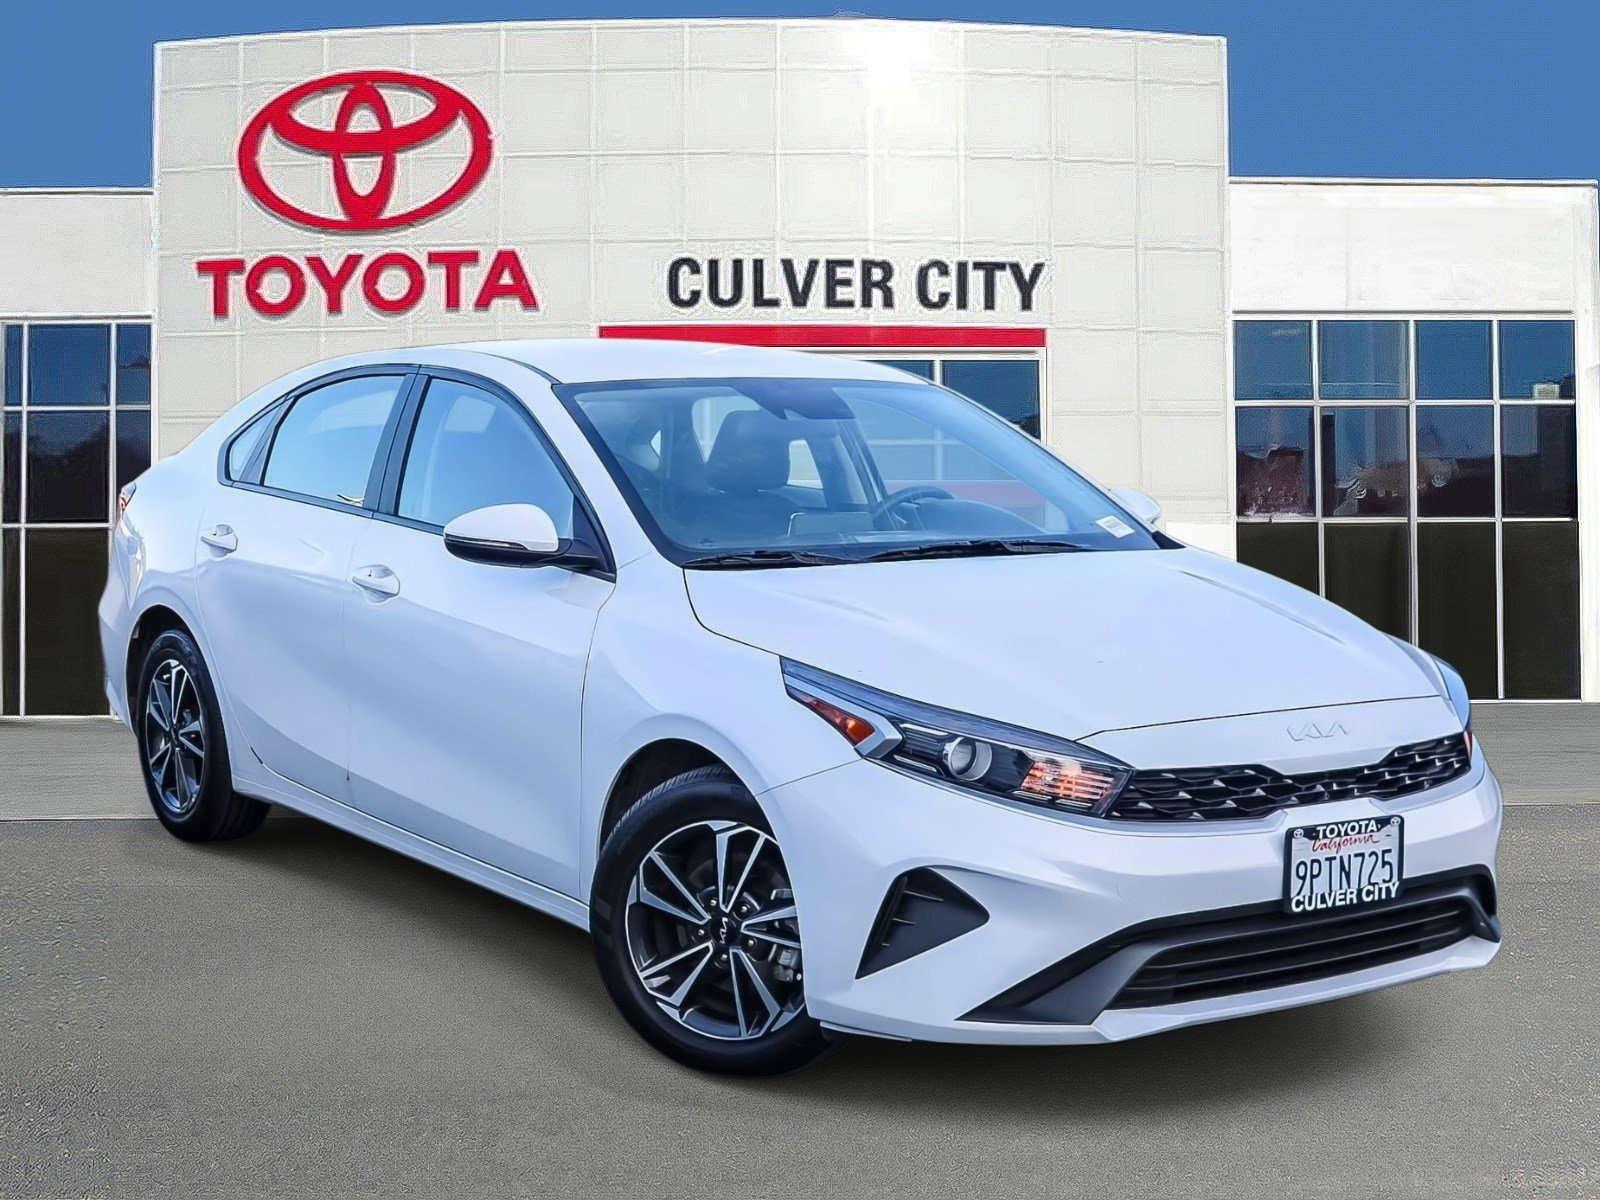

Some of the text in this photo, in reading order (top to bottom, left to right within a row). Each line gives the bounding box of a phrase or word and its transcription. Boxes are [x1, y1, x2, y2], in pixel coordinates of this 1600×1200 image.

[195, 249, 540, 318] TOYOTA
[667, 257, 1046, 312] CULVER CITY
[1312, 834, 1379, 853] California
[1316, 820, 1378, 838] TOYOTA
[1296, 849, 1394, 897] 9PTN725
[1291, 881, 1400, 912] CULVER CITY
